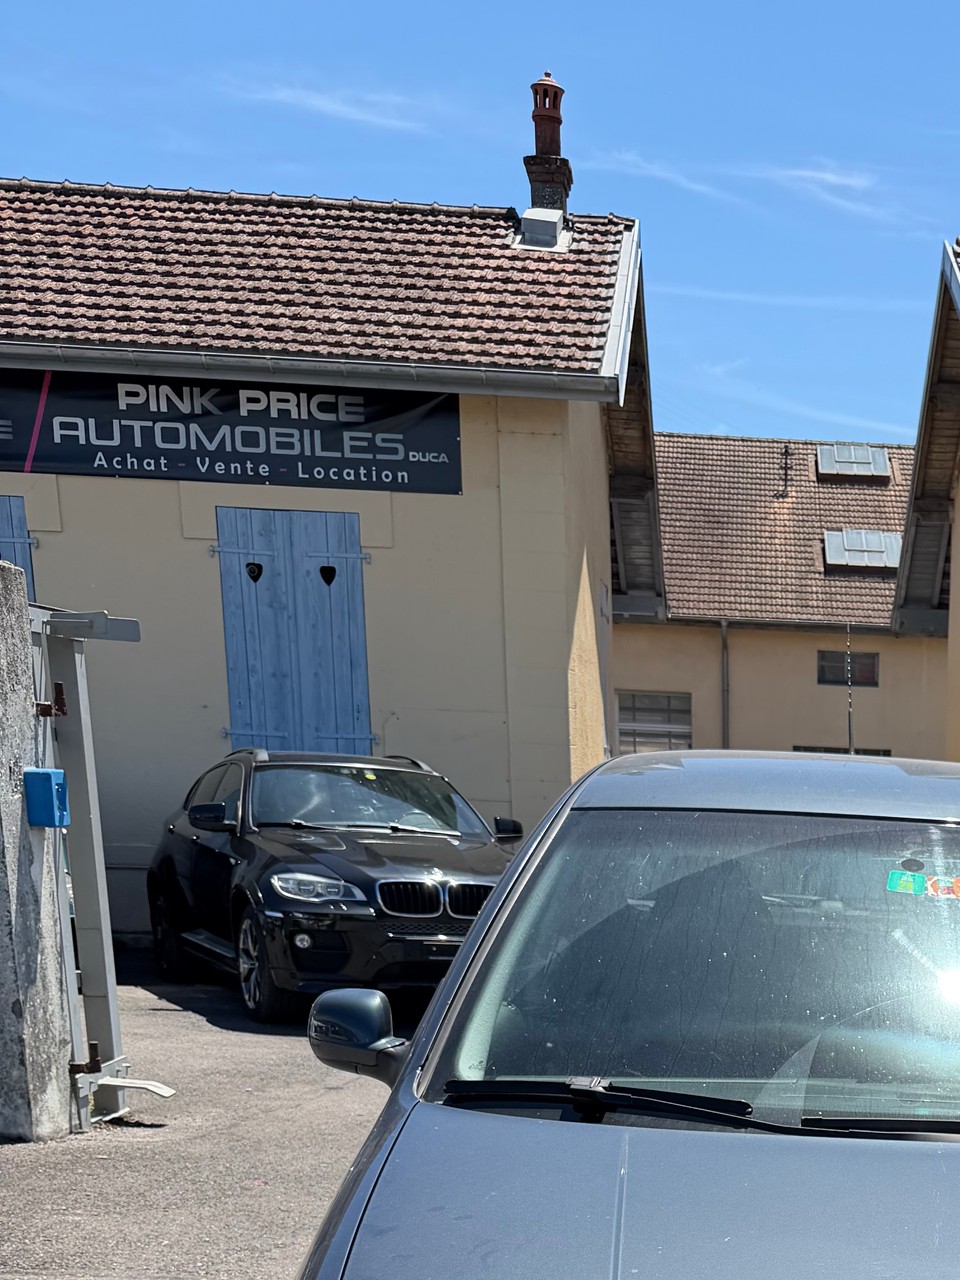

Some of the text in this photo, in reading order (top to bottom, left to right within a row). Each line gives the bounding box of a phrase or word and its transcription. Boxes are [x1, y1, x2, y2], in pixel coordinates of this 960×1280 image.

[118, 383, 365, 423] PINK PRICE
[52, 416, 449, 463] AUTOMOBILES DUCA
[94, 452, 168, 471] Achat
[197, 457, 270, 477] Vente
[298, 462, 409, 484] Location
